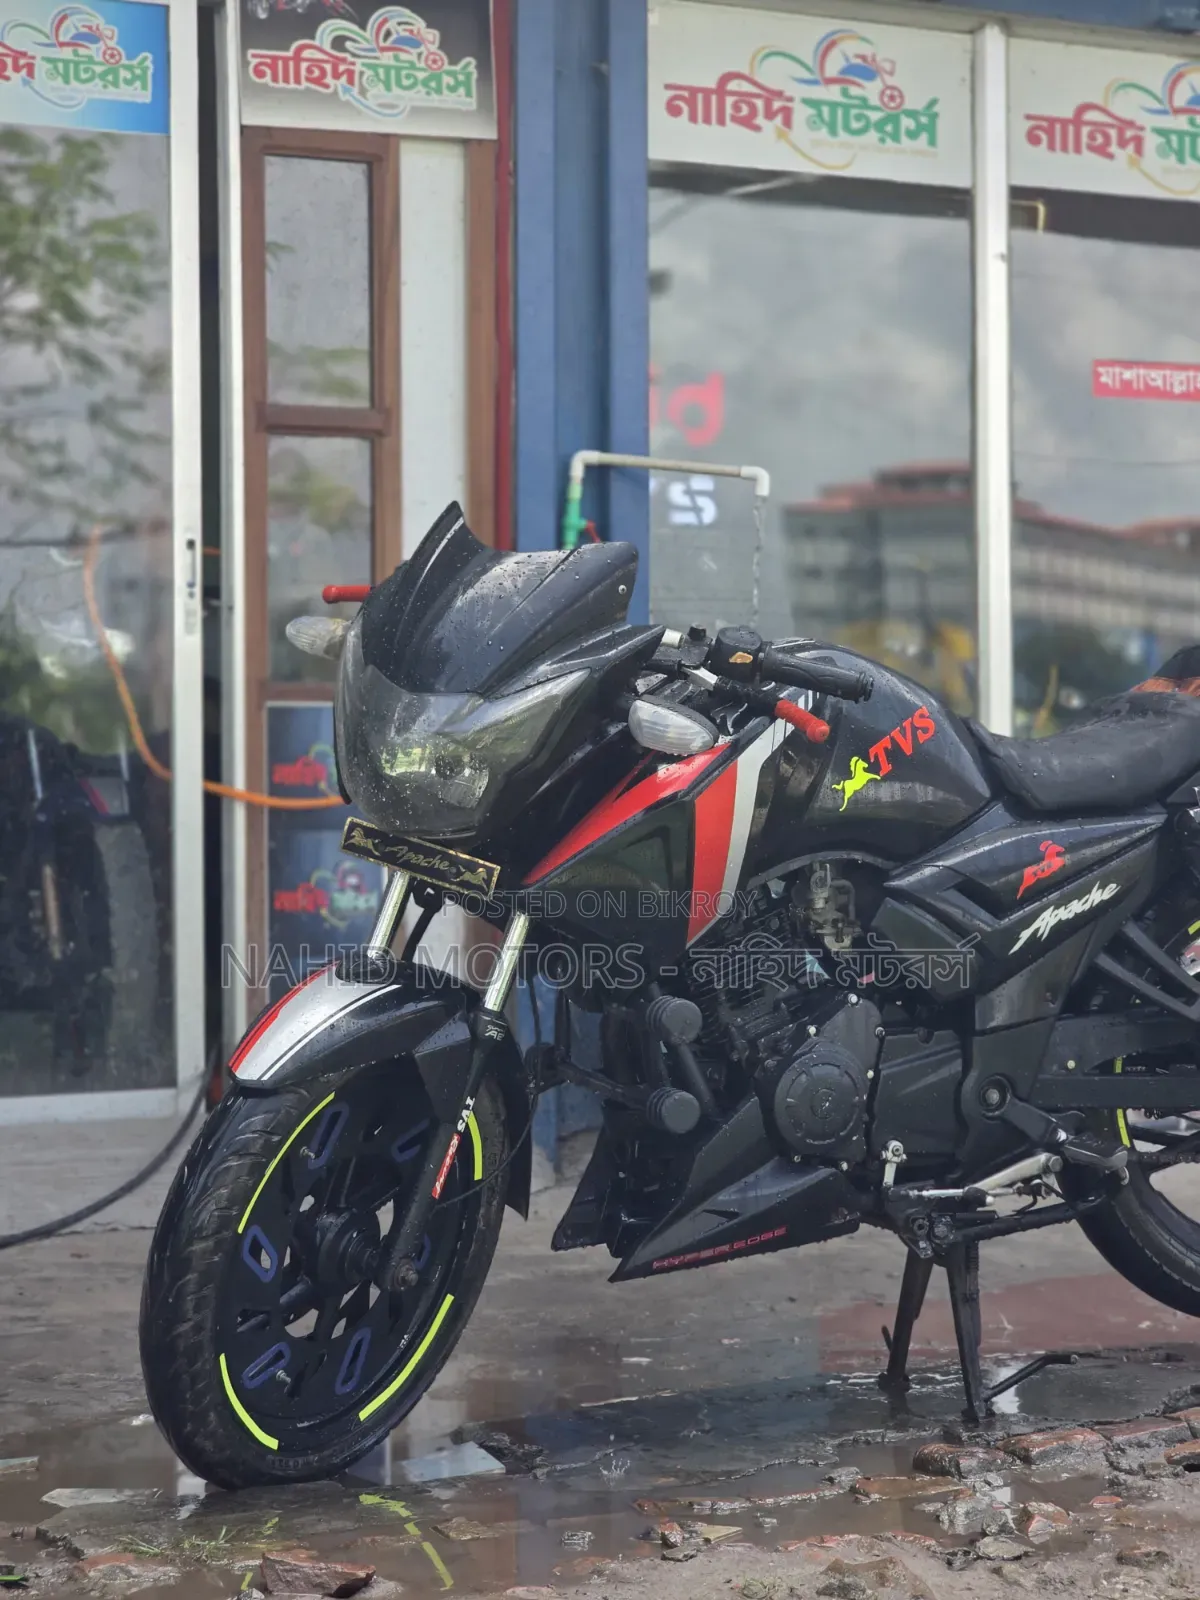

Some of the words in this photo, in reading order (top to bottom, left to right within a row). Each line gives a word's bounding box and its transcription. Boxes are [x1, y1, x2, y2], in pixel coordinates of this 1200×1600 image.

[251, 42, 356, 90] নাহিদ
[664, 71, 795, 132] নাহিদ
[1024, 102, 1146, 161] নাহিদ
[1097, 366, 1200, 395] মাশাআল্লা
[868, 706, 936, 777] TVS
[385, 845, 450, 870] Apache
[1008, 881, 1121, 956] Apache
